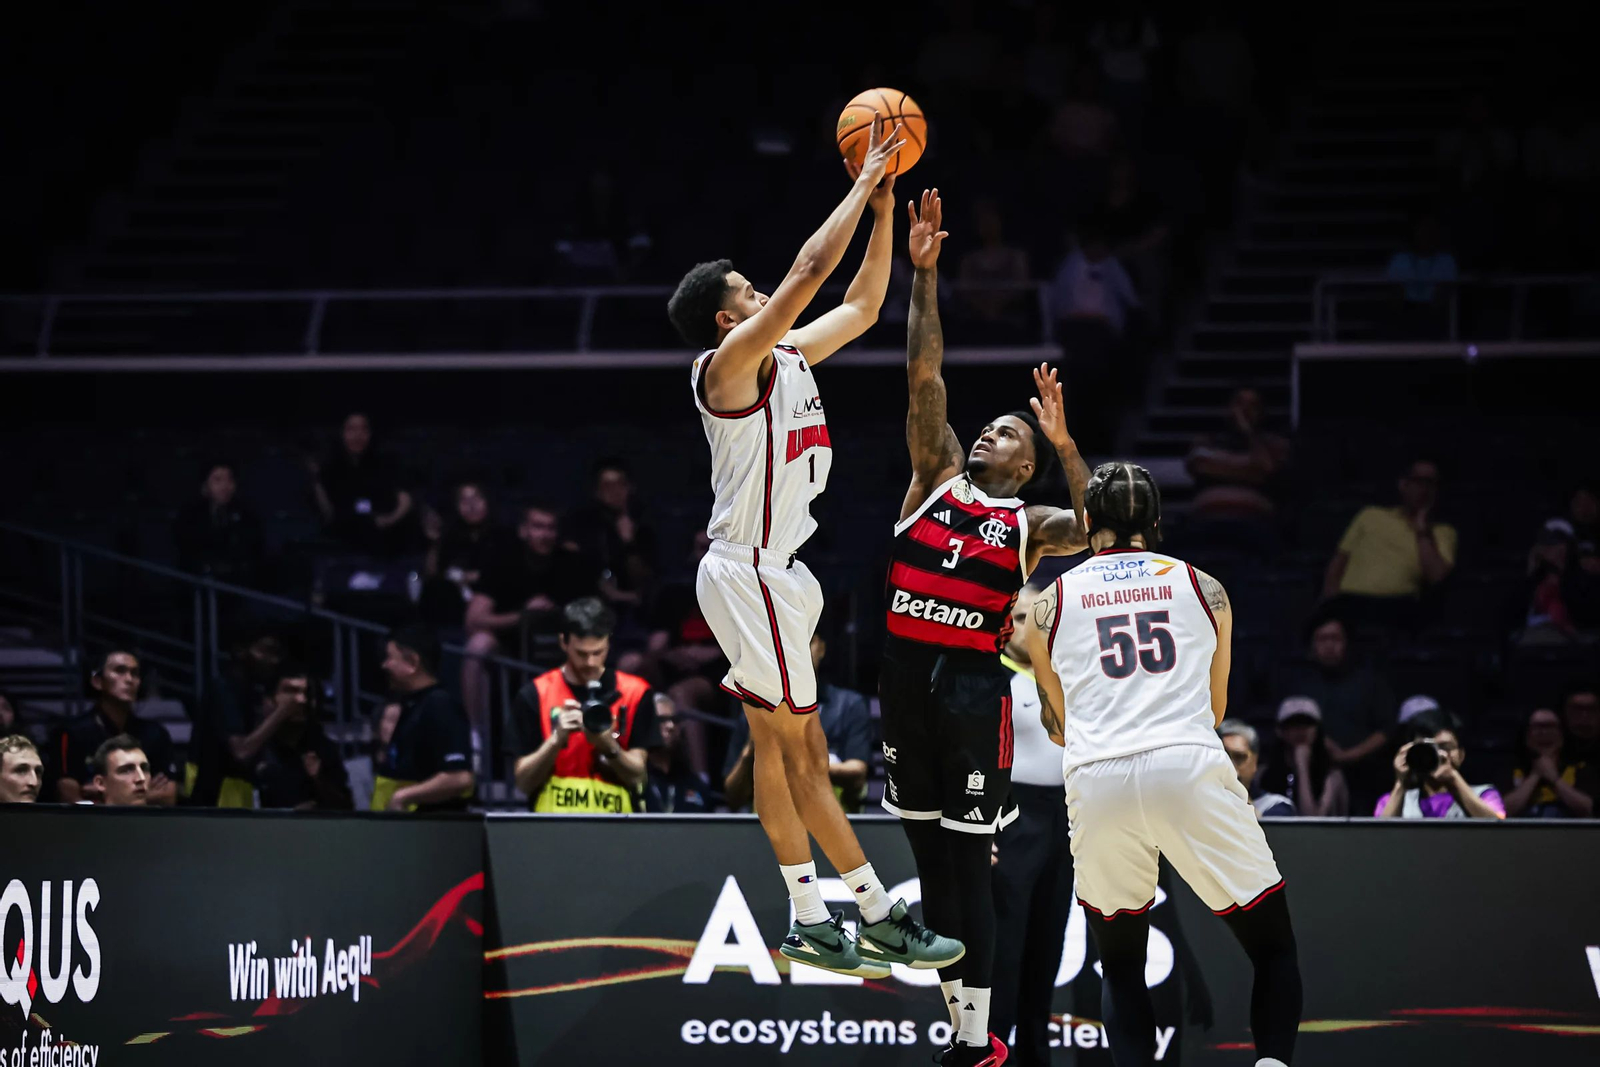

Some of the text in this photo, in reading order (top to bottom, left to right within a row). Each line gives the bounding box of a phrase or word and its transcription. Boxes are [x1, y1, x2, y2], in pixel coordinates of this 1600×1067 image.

[808, 453, 816, 484] 1
[941, 538, 964, 569] 3
[891, 589, 984, 629] Betano
[1081, 585, 1173, 609] McLAUGHLIN
[1096, 610, 1176, 679] 55
[228, 940, 269, 1001] Win
[274, 936, 318, 998] with
[11, 1029, 28, 1067] of
[30, 1028, 99, 1067] efficiency
[681, 1010, 918, 1053] ecosystems
